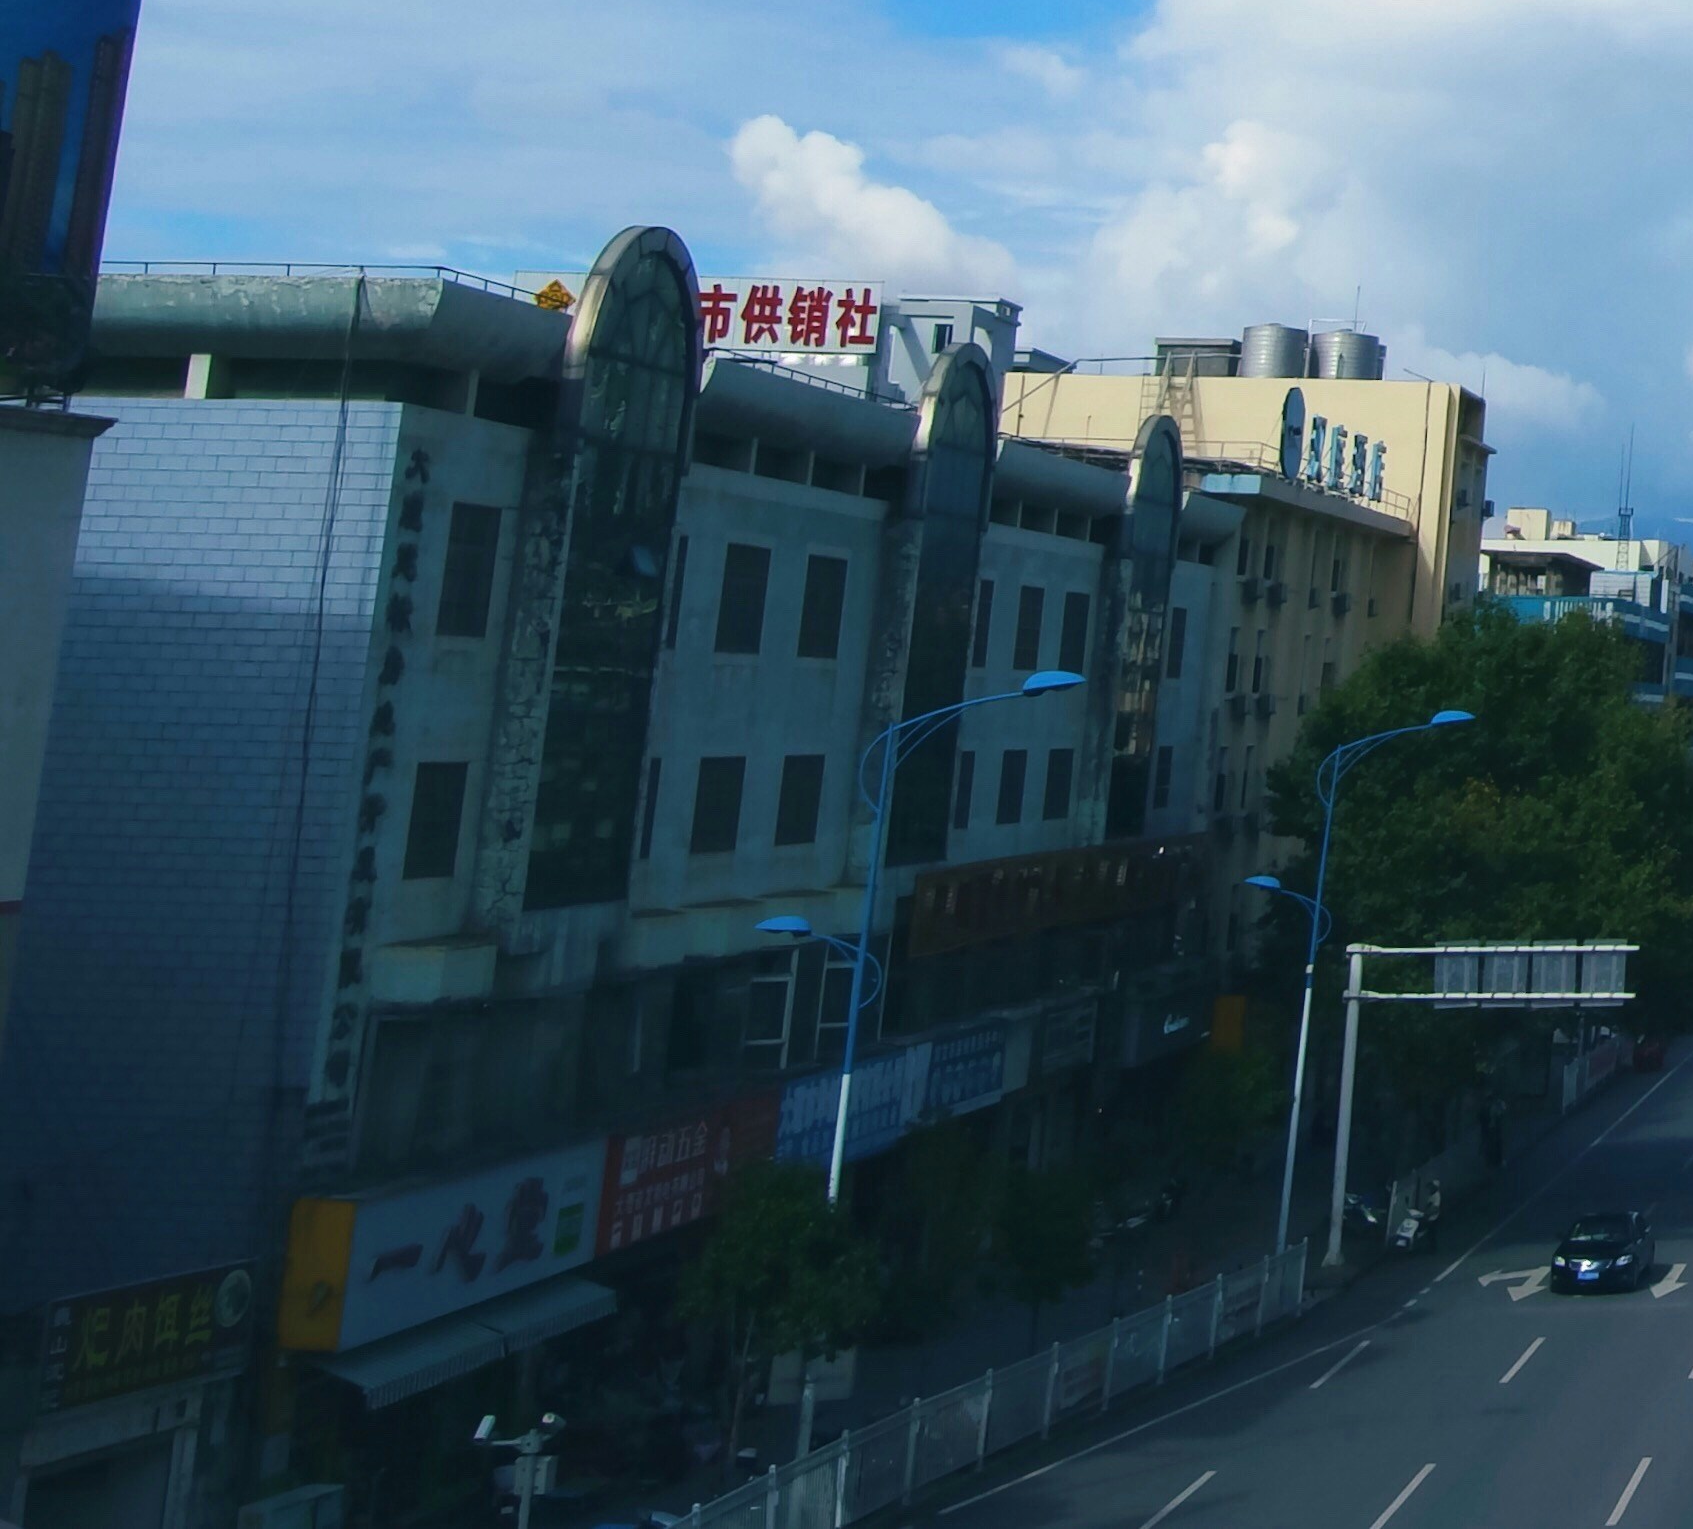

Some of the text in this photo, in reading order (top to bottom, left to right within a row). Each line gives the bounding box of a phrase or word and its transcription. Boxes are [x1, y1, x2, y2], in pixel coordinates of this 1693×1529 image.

[699, 284, 878, 347] 市供销社
[369, 1176, 549, 1283] 一心堂
